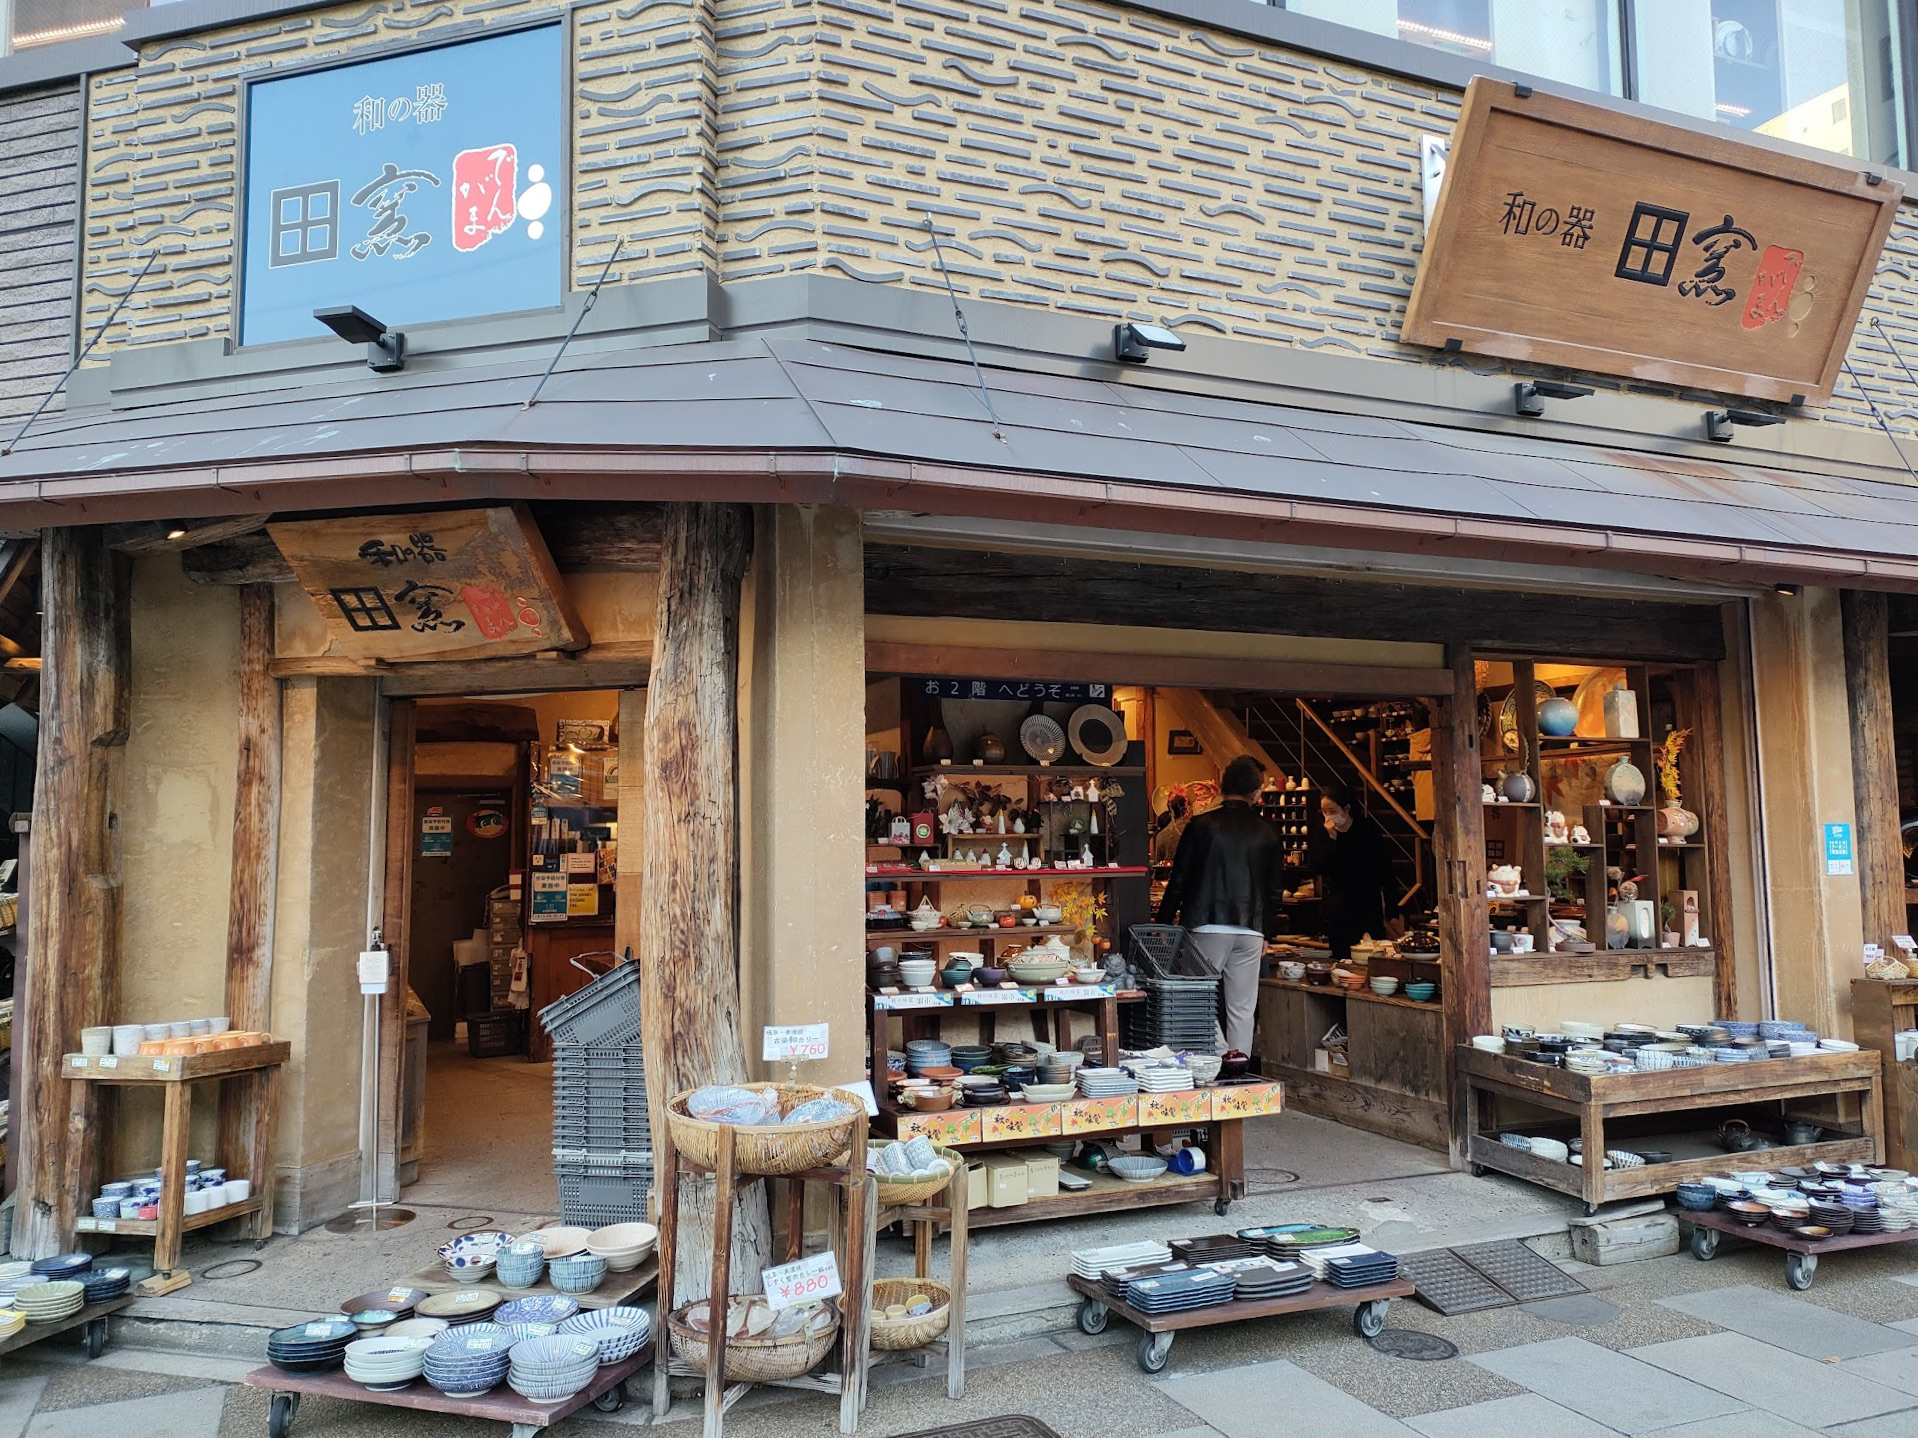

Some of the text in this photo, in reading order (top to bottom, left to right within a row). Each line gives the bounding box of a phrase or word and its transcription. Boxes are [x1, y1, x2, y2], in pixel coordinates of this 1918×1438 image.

[352, 82, 448, 135] 和の器
[1498, 190, 1595, 249] 和の器
[359, 533, 447, 567] 和の器
